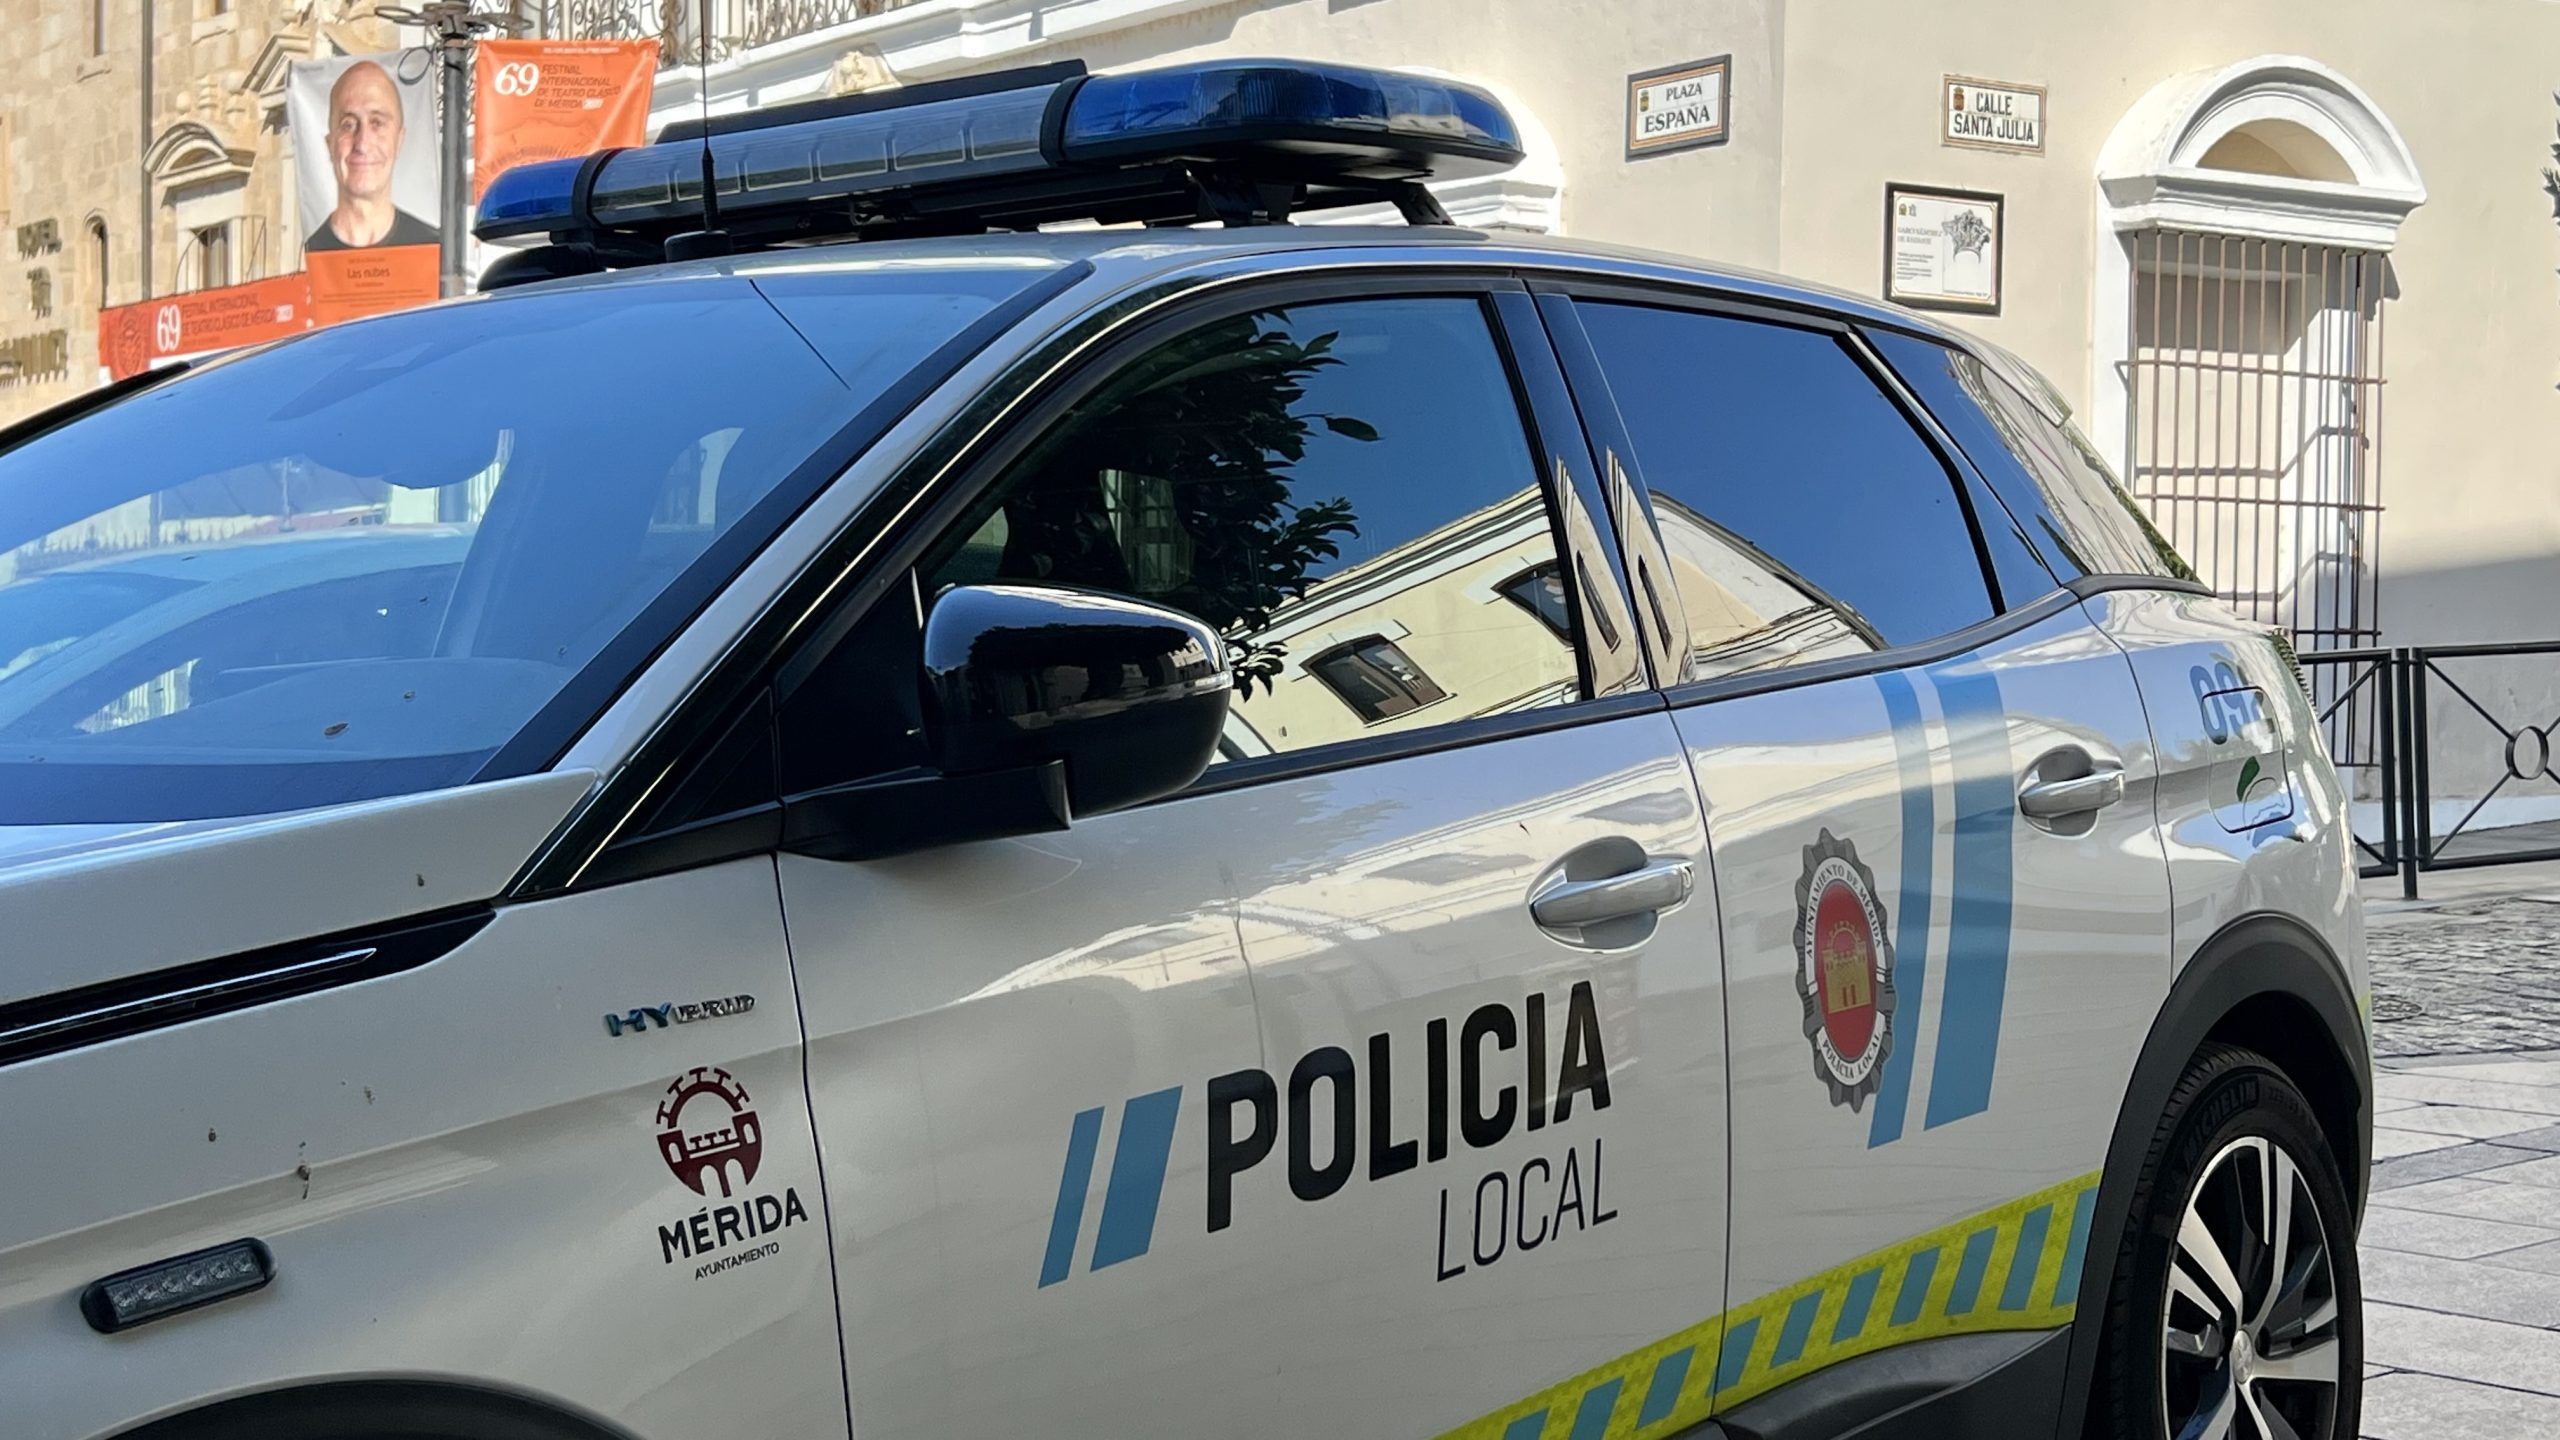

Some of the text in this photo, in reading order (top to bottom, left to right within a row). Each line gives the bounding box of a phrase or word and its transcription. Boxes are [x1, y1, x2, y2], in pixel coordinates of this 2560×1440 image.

[494, 62, 539, 97] 69
[1665, 82, 1703, 101] PLAZA
[1644, 103, 1710, 133] ESPAÑA
[1976, 92, 2012, 116] CALLE
[1953, 113, 2034, 142] SANTA JULIA
[157, 304, 182, 353] 69
[1207, 980, 1611, 1234] POLICIA
[657, 1187, 809, 1265] MÉRIDA
[1437, 1137, 1618, 1283] LOCAL
[694, 1241, 780, 1281] AYUNTAMIENTO
